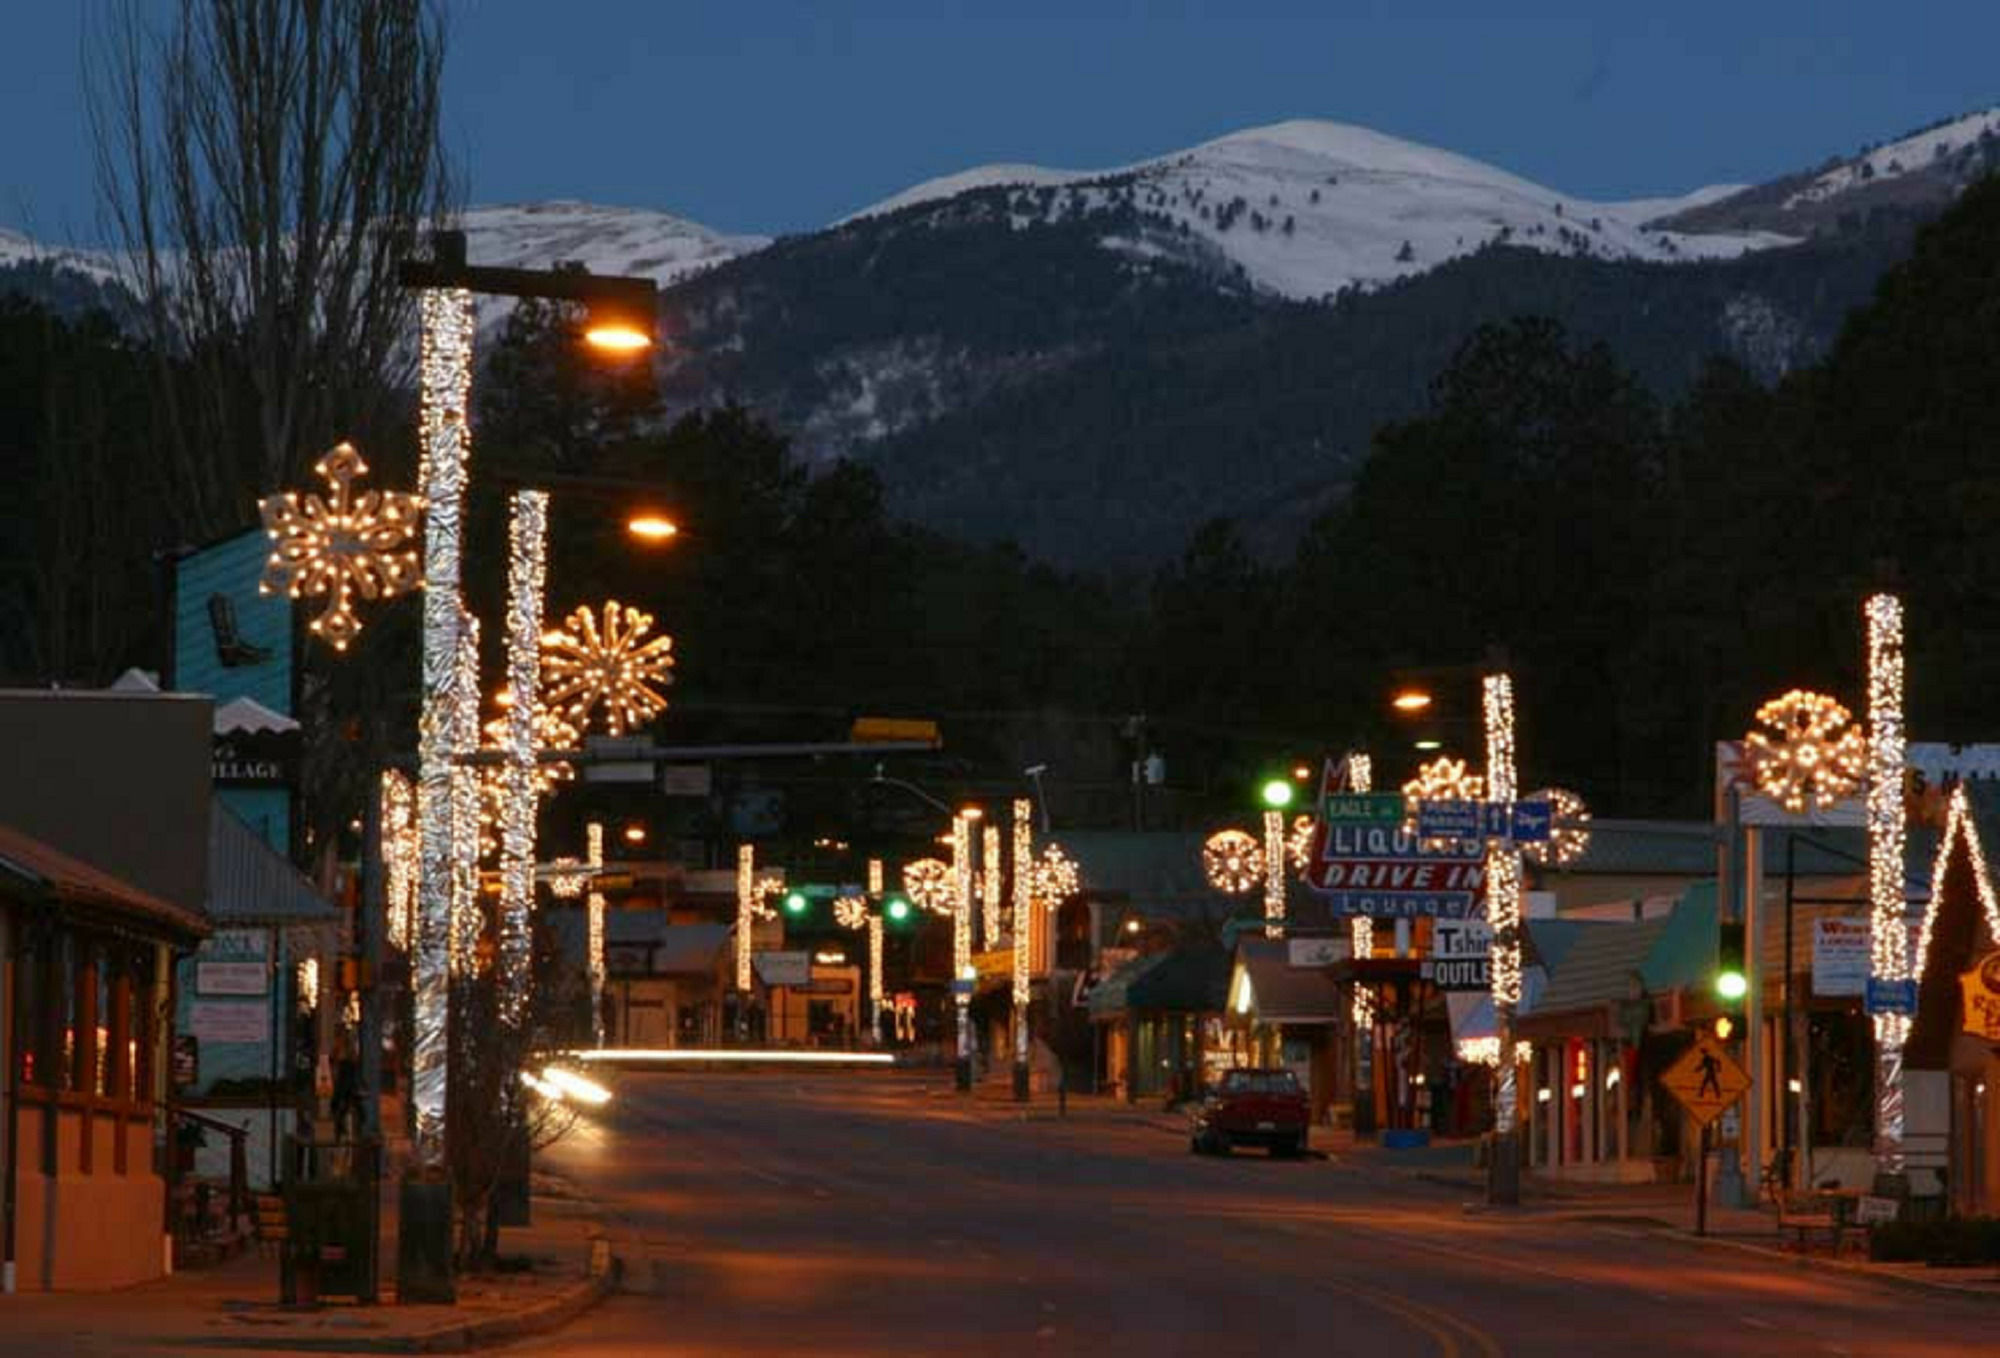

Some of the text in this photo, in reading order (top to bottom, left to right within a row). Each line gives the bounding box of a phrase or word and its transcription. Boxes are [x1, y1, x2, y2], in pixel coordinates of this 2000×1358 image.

[211, 762, 279, 779] ILLAGE
[1324, 864, 1485, 889] DRIVE IN
[1343, 895, 1462, 916] Lounge
[1436, 961, 1491, 985] OUTLE
